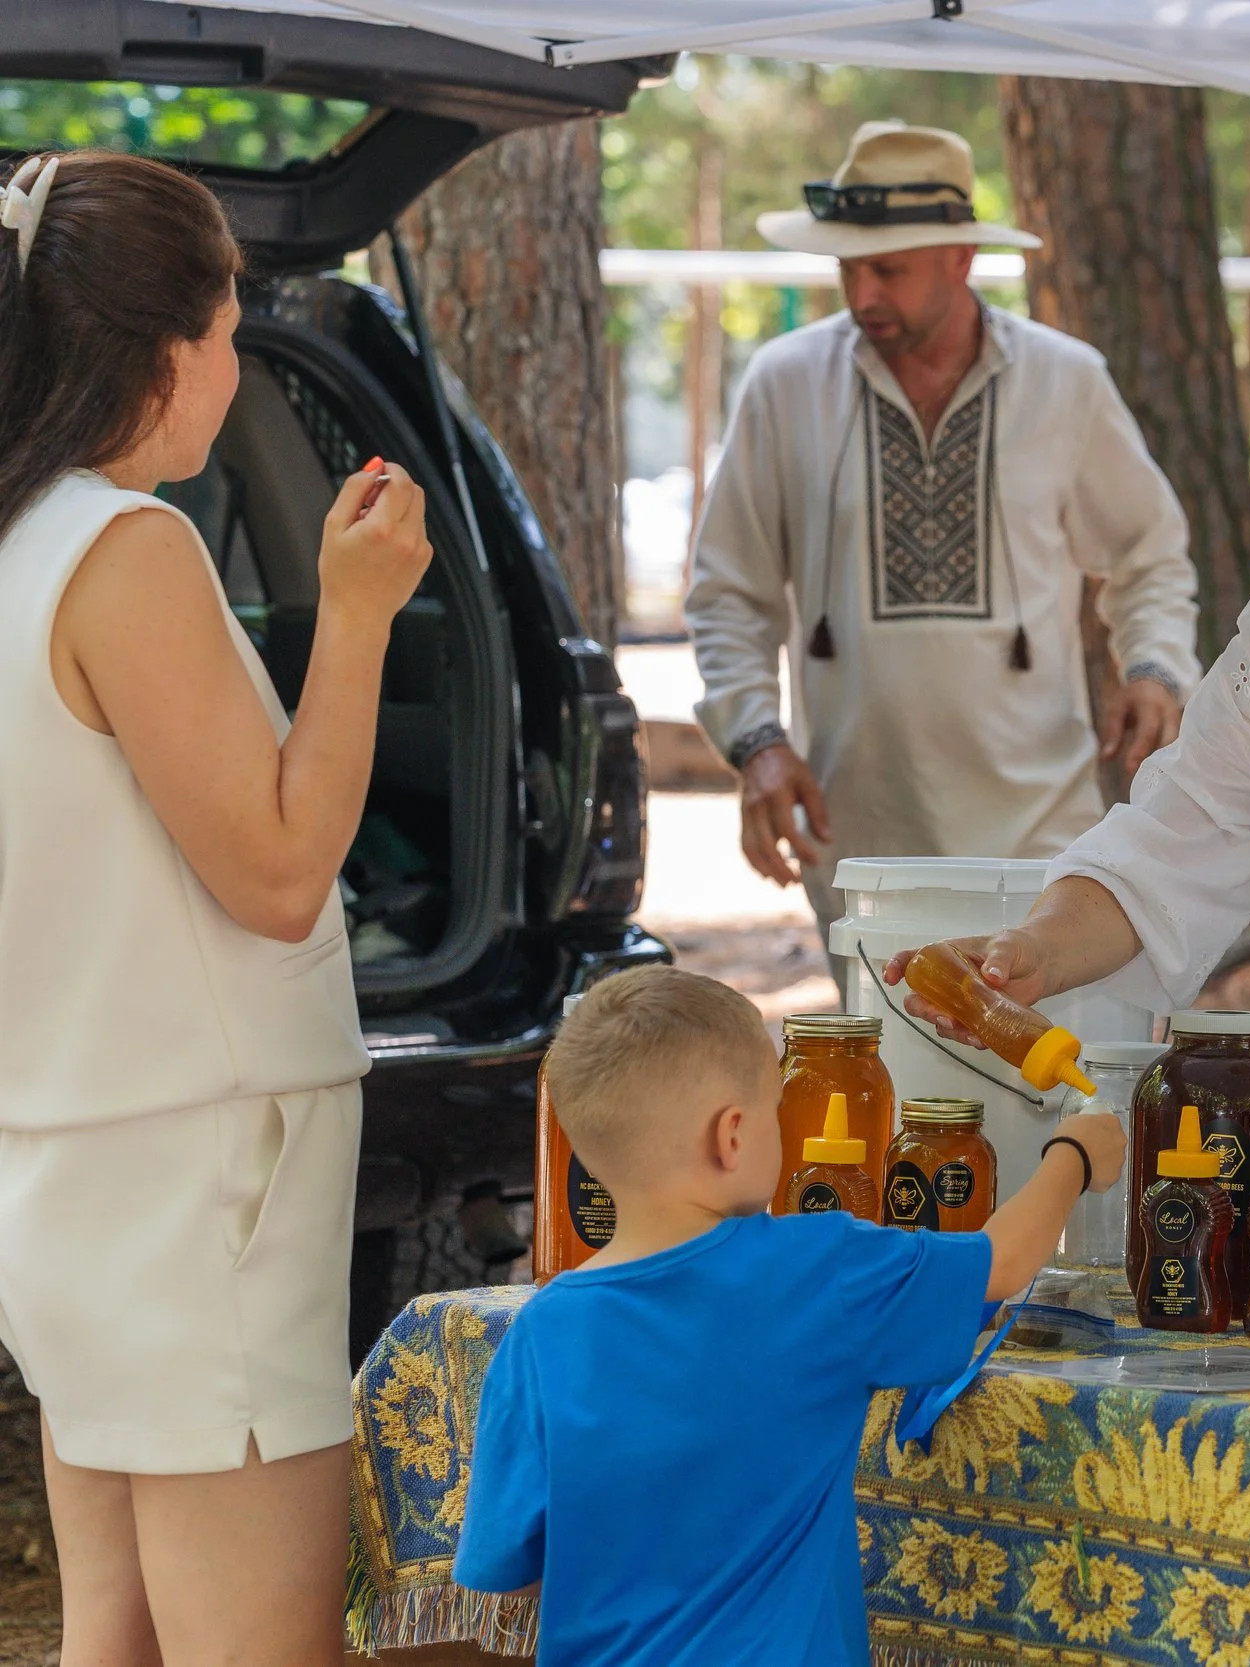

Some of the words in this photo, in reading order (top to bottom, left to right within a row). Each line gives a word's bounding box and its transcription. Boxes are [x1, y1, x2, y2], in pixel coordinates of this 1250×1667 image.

[940, 1175, 969, 1192] Spring
[1231, 1183, 1245, 1191] BEES
[591, 1198, 611, 1206] HONEY
[804, 1197, 833, 1210] Local
[1160, 1212, 1189, 1225] Local
